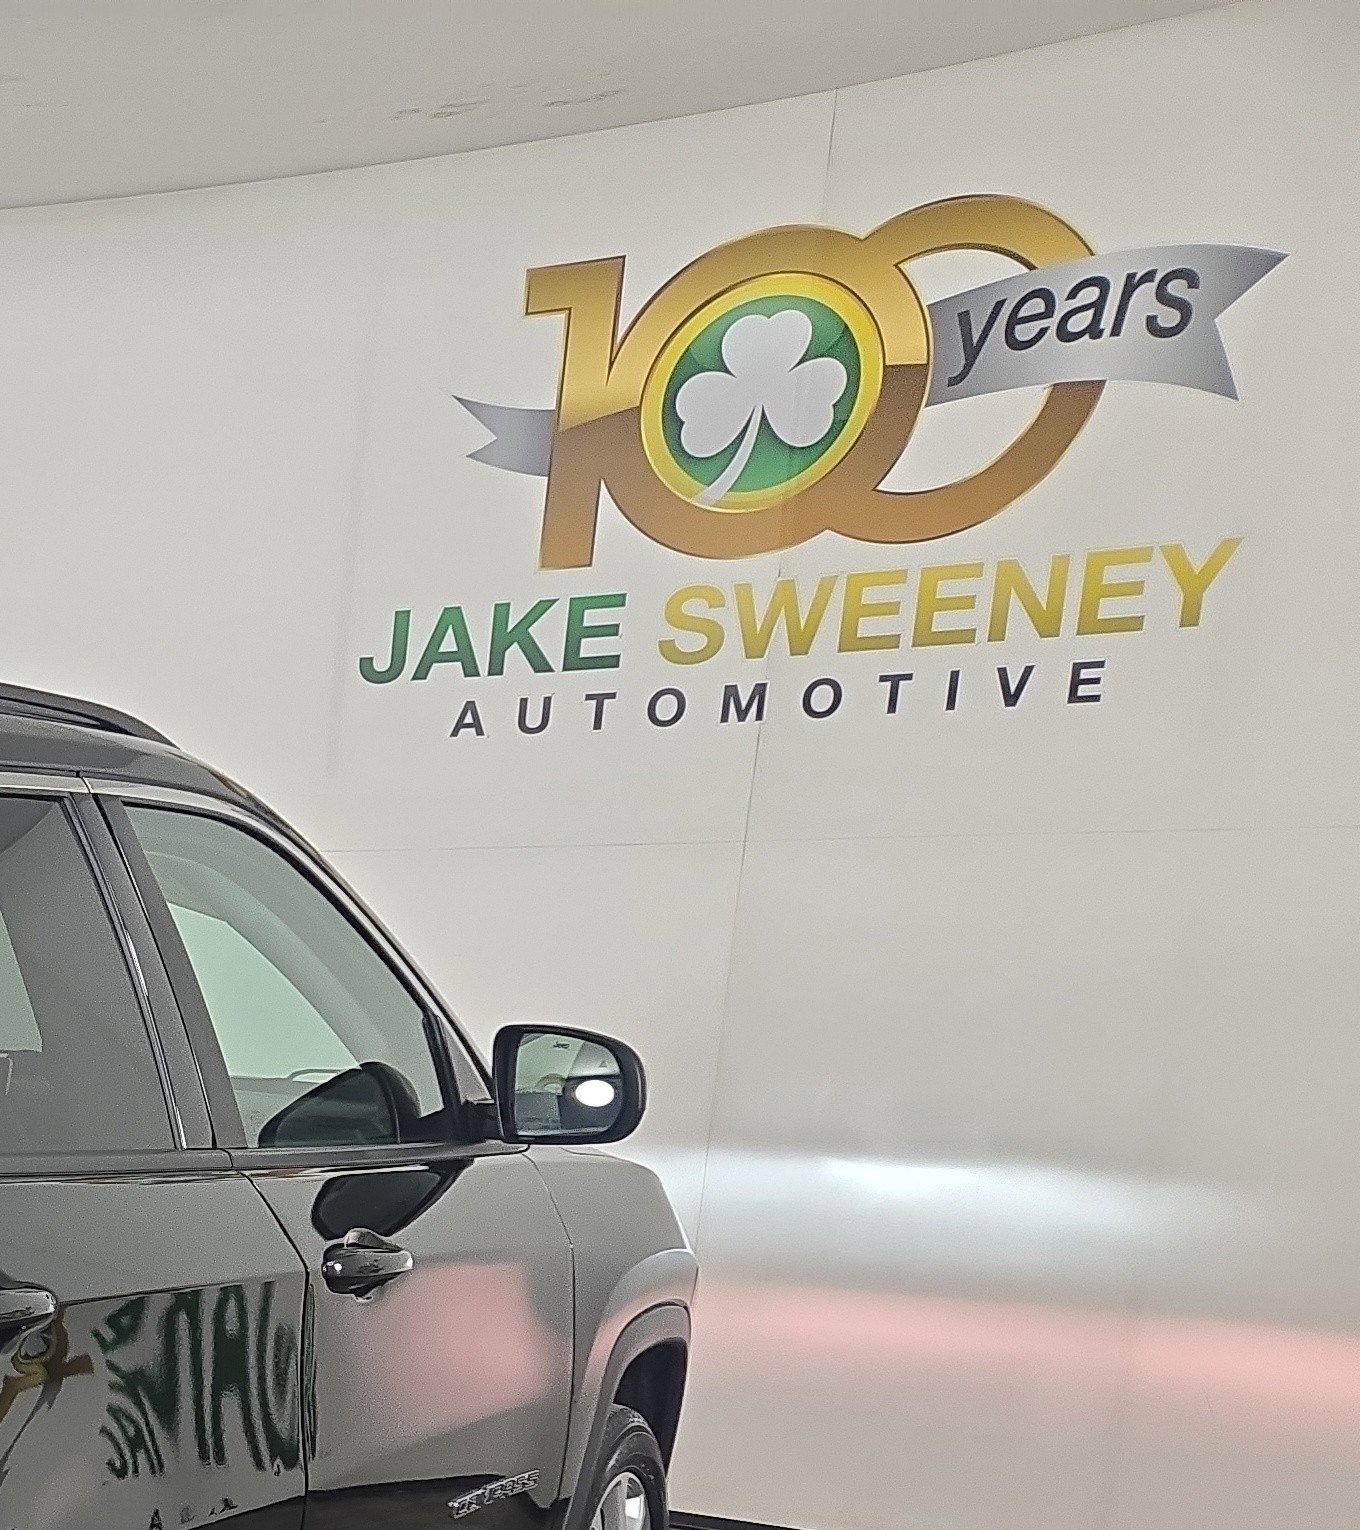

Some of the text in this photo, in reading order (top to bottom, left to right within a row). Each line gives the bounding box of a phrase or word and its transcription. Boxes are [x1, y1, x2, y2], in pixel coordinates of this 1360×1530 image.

[523, 193, 1201, 571] 100 years
[357, 535, 1244, 686] JAKE SWEENEY
[450, 659, 1108, 738] AUTOMOTIVE
